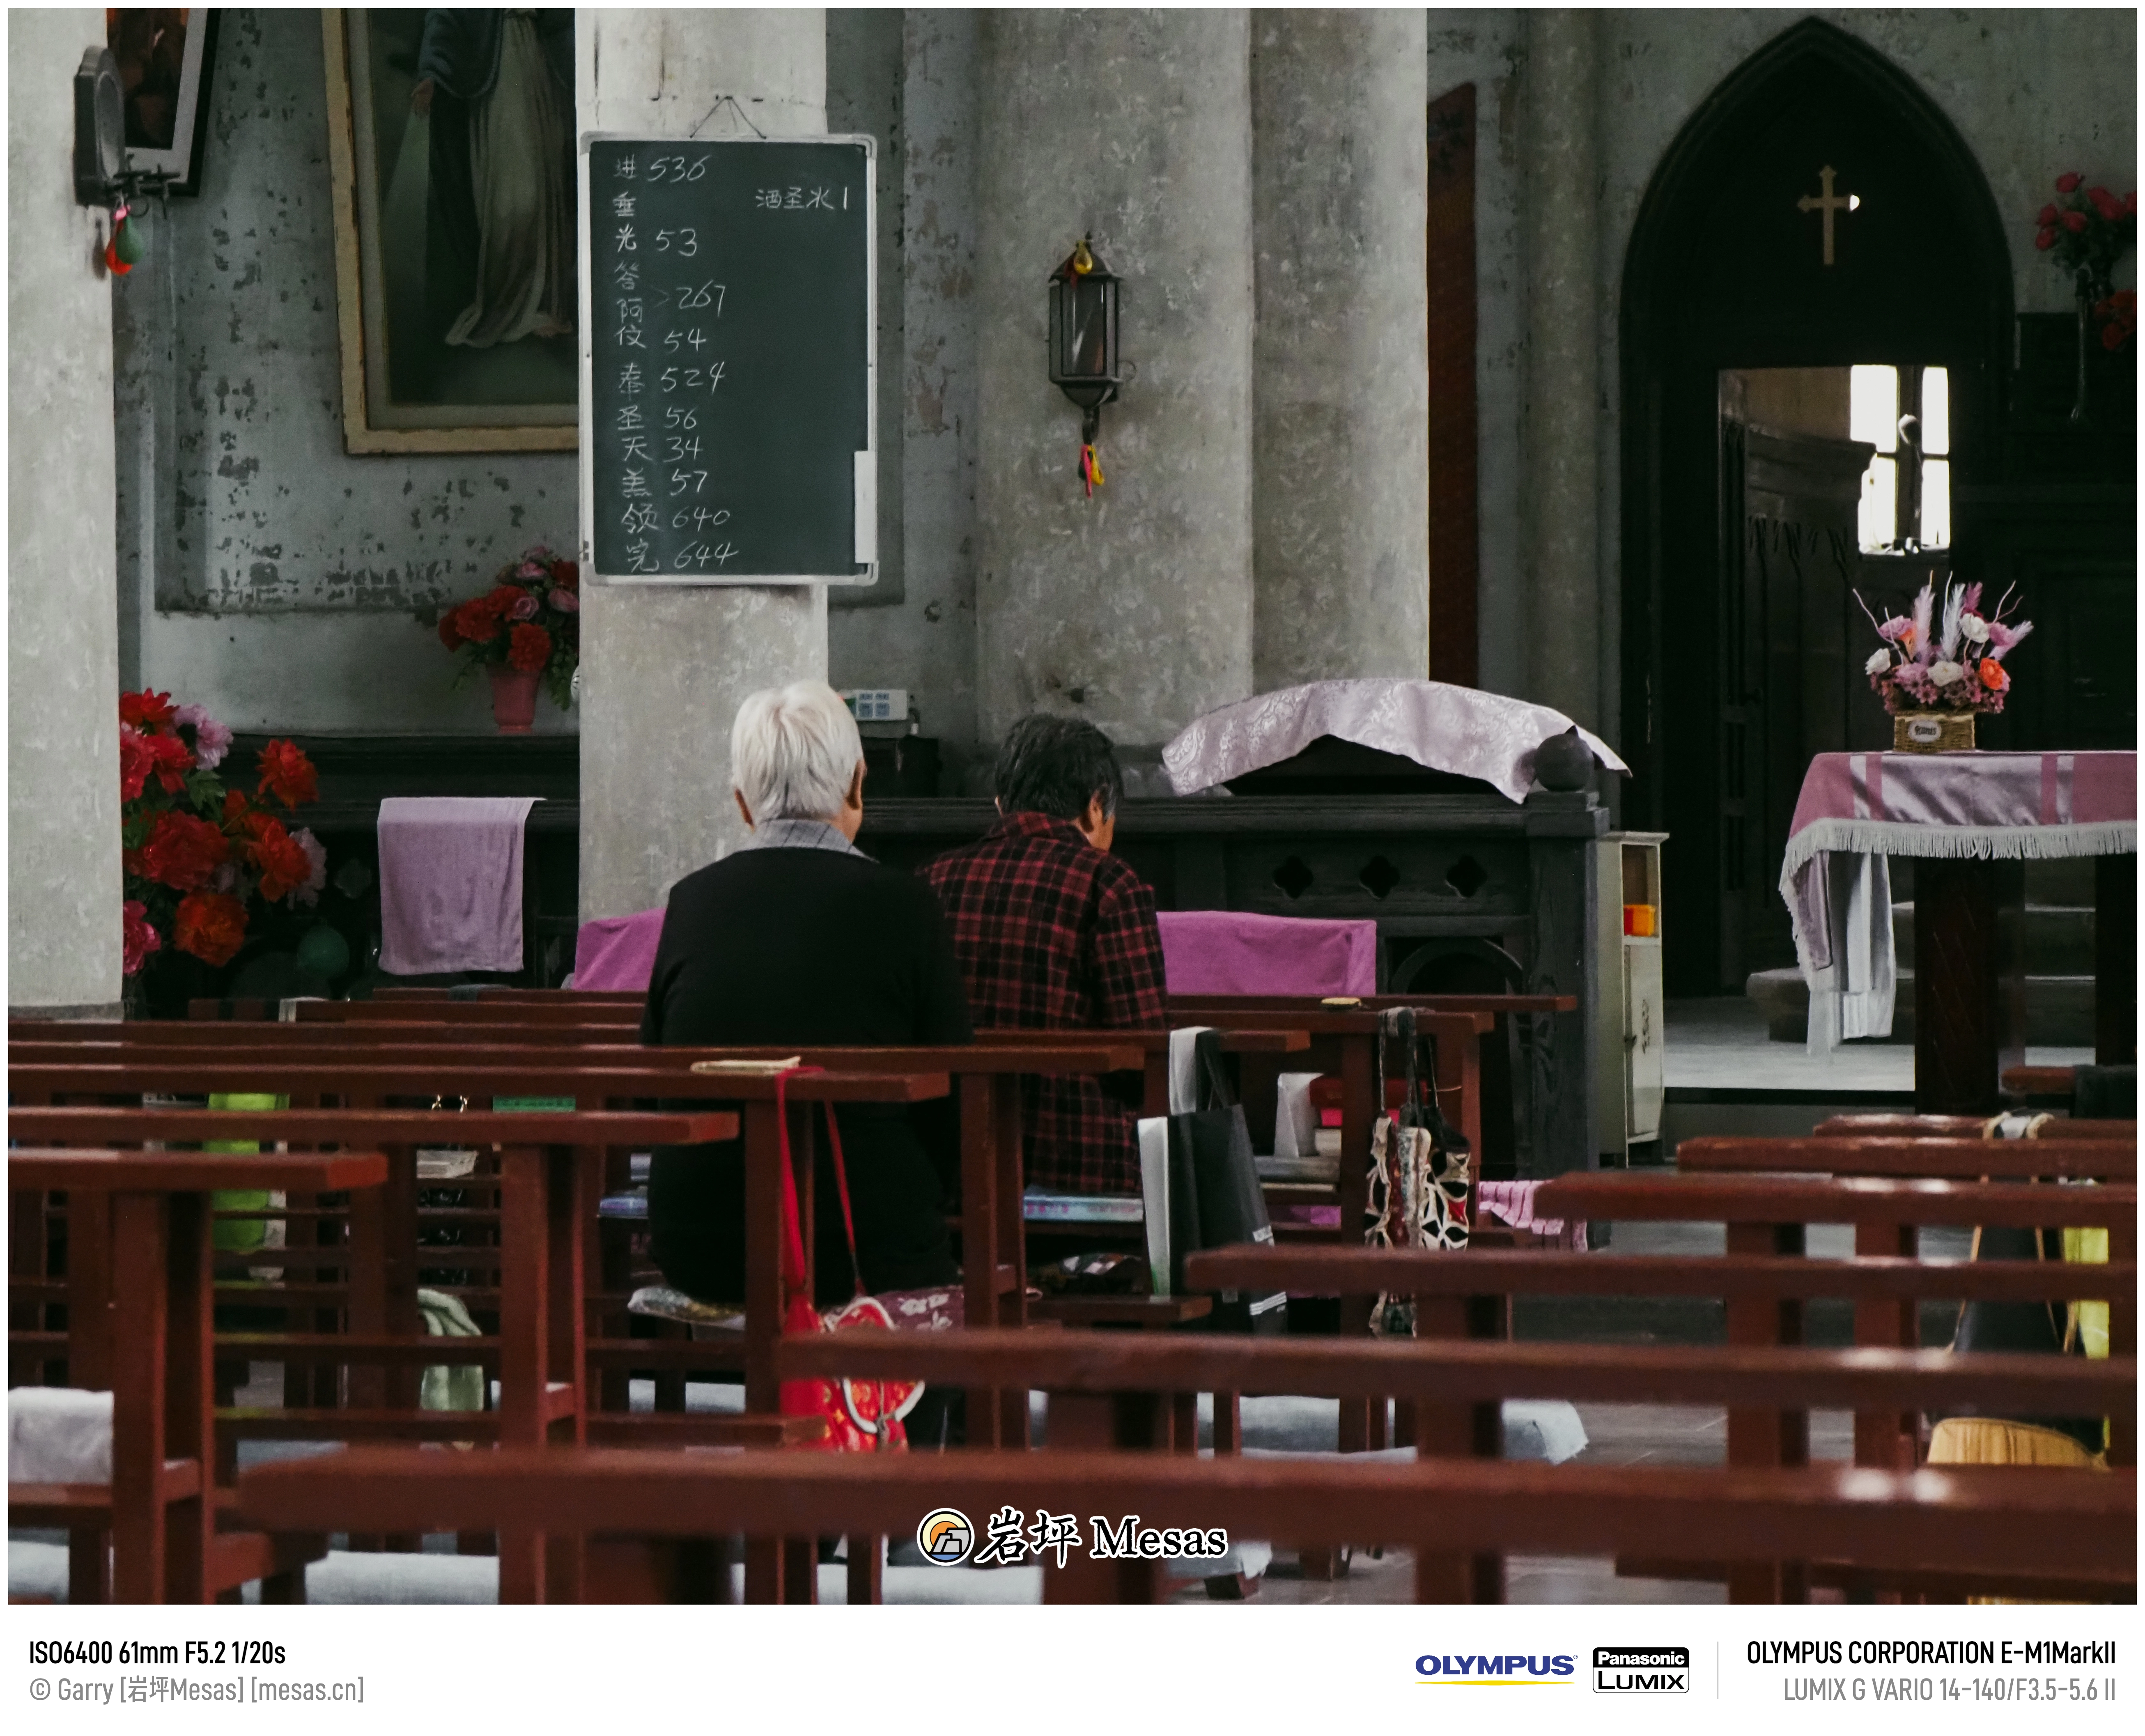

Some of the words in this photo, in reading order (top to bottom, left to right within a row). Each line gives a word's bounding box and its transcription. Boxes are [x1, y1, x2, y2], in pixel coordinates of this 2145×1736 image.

[614, 154, 636, 179] 进
[647, 155, 711, 183] 536
[613, 191, 636, 217] 垂
[615, 223, 637, 253] 光
[656, 228, 697, 257] 53
[614, 260, 639, 290] 答
[616, 297, 643, 324] 阿
[676, 279, 726, 317] 267
[664, 328, 707, 352] 54
[660, 361, 725, 395] 524
[617, 404, 645, 431] 圣
[664, 406, 697, 429] 56
[621, 436, 654, 462] 天
[663, 436, 703, 462] 34
[670, 468, 708, 496] 57
[621, 503, 659, 534] 领
[672, 507, 730, 532] 640
[674, 541, 739, 569] 644
